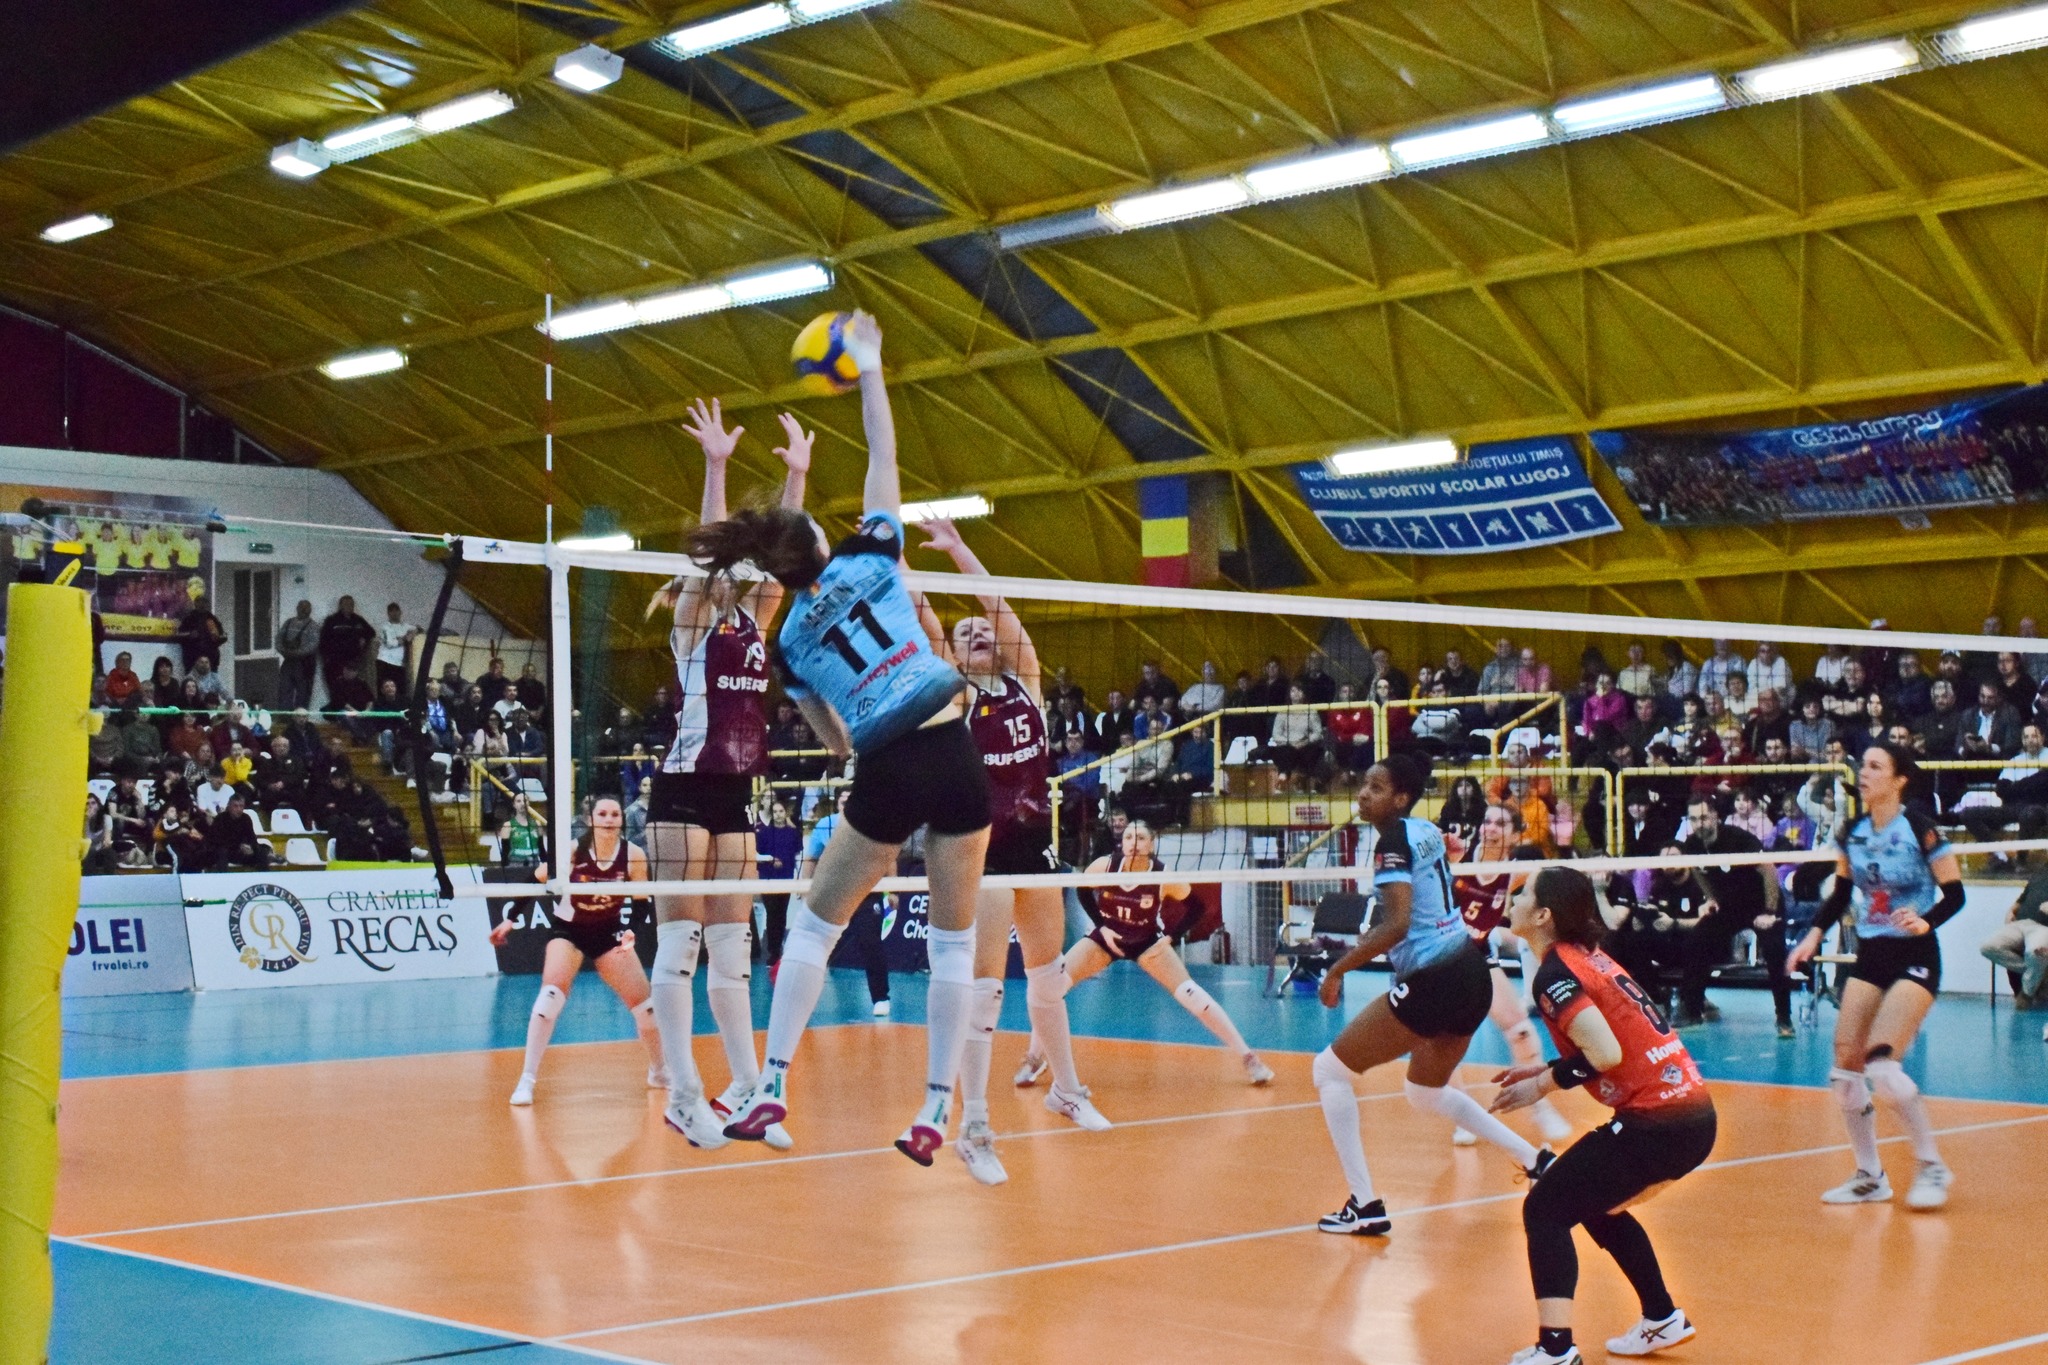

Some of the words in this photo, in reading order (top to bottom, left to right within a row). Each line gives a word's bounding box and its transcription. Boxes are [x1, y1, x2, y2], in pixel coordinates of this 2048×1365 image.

[1309, 487, 1368, 500] CLUBUL
[1368, 482, 1436, 499] SPORTIV
[1440, 475, 1508, 497] ȘCOLAR
[1509, 464, 1571, 487] LUGOJ
[821, 598, 896, 675] 11
[1003, 713, 1032, 747] 15
[231, 884, 269, 920] RESPECT
[273, 886, 310, 925] PENTRU
[908, 894, 929, 914] CE
[1116, 905, 1132, 920] 11
[1464, 900, 1484, 921] 5
[230, 923, 244, 946] DIN
[298, 931, 310, 953] VIN
[329, 914, 458, 972] RECAȘ
[92, 959, 149, 971] frvolei.ro
[265, 957, 294, 970] 1447
[1612, 972, 1672, 1037] 8
